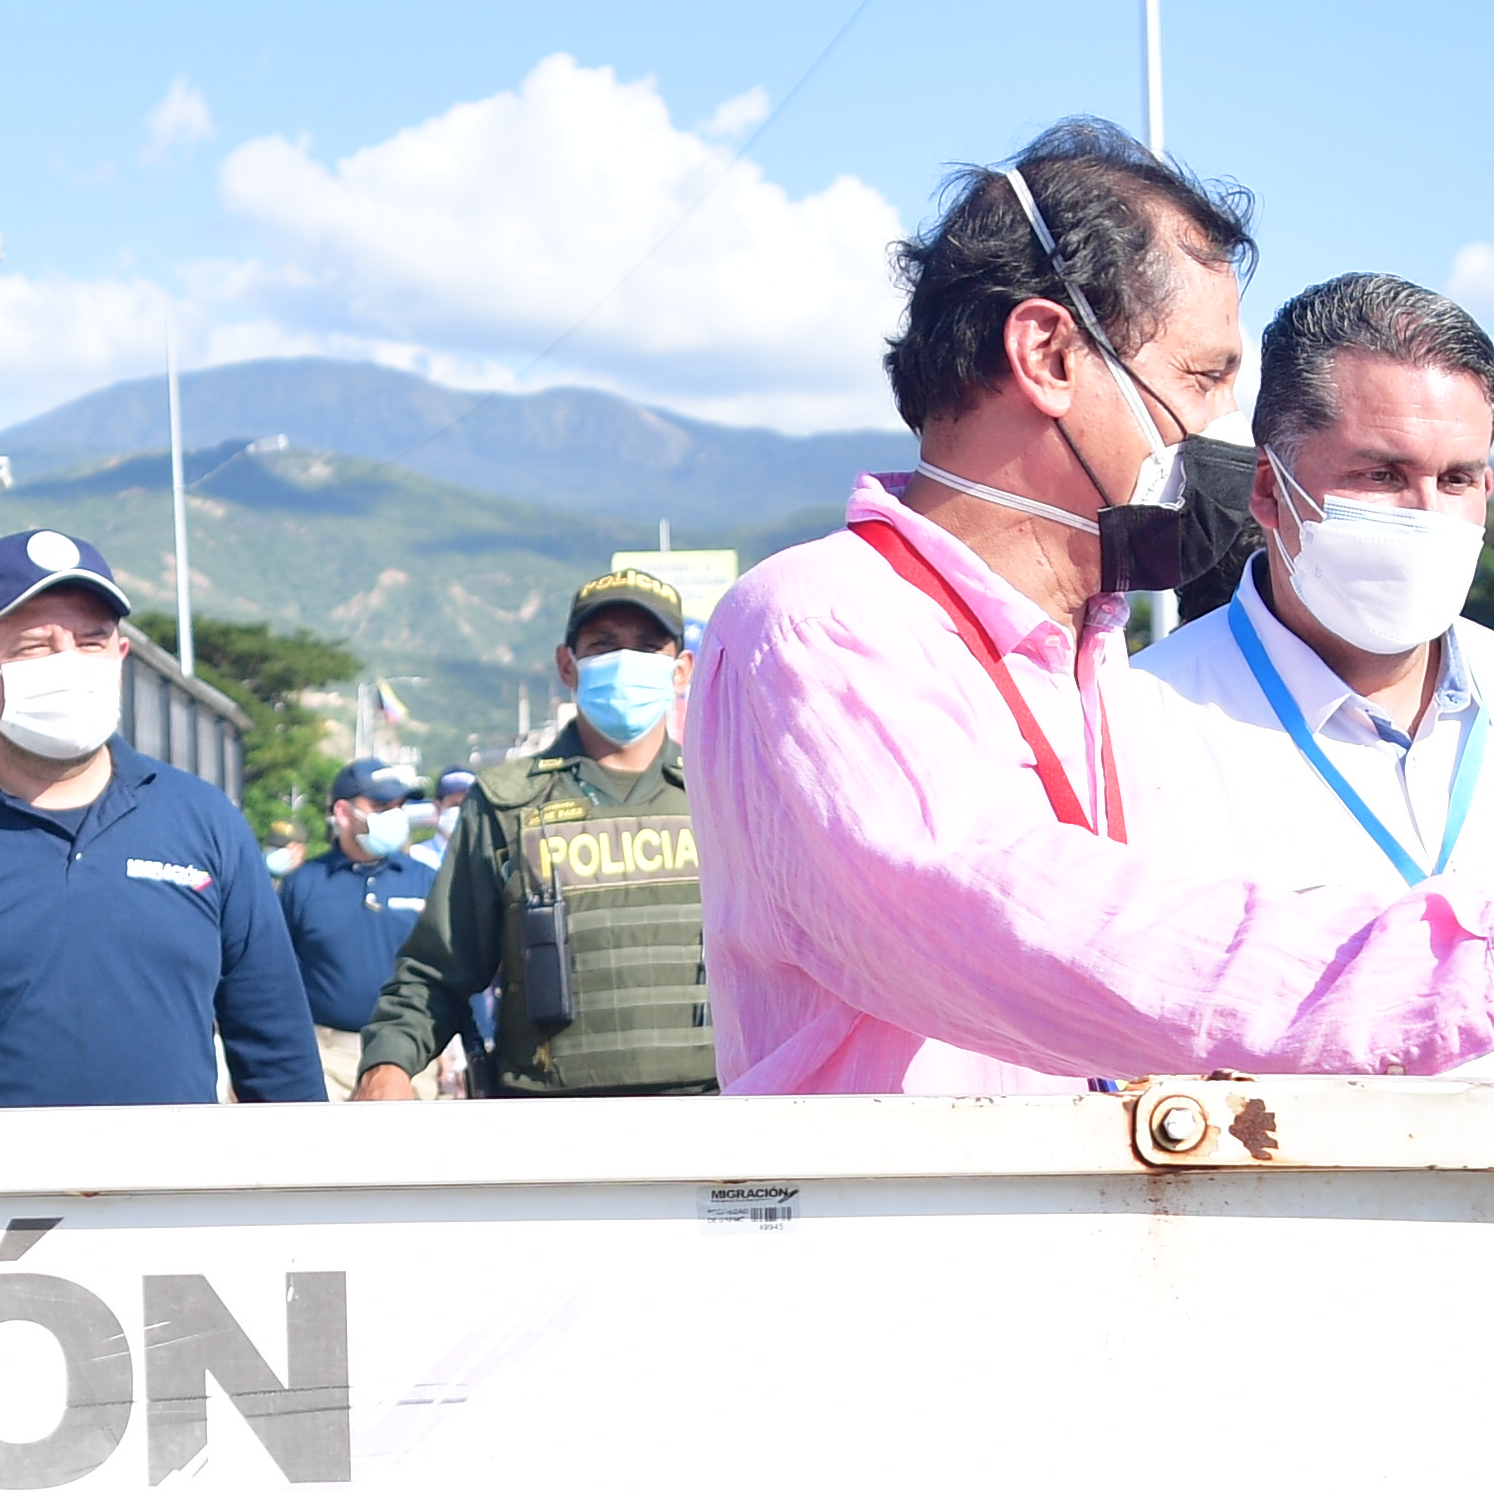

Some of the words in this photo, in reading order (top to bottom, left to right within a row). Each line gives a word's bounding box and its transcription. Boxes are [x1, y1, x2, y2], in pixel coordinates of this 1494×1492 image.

[580, 569, 678, 603] POLICIA
[539, 828, 699, 879] POLICIA
[711, 1186, 788, 1199] MIGRACIÓN
